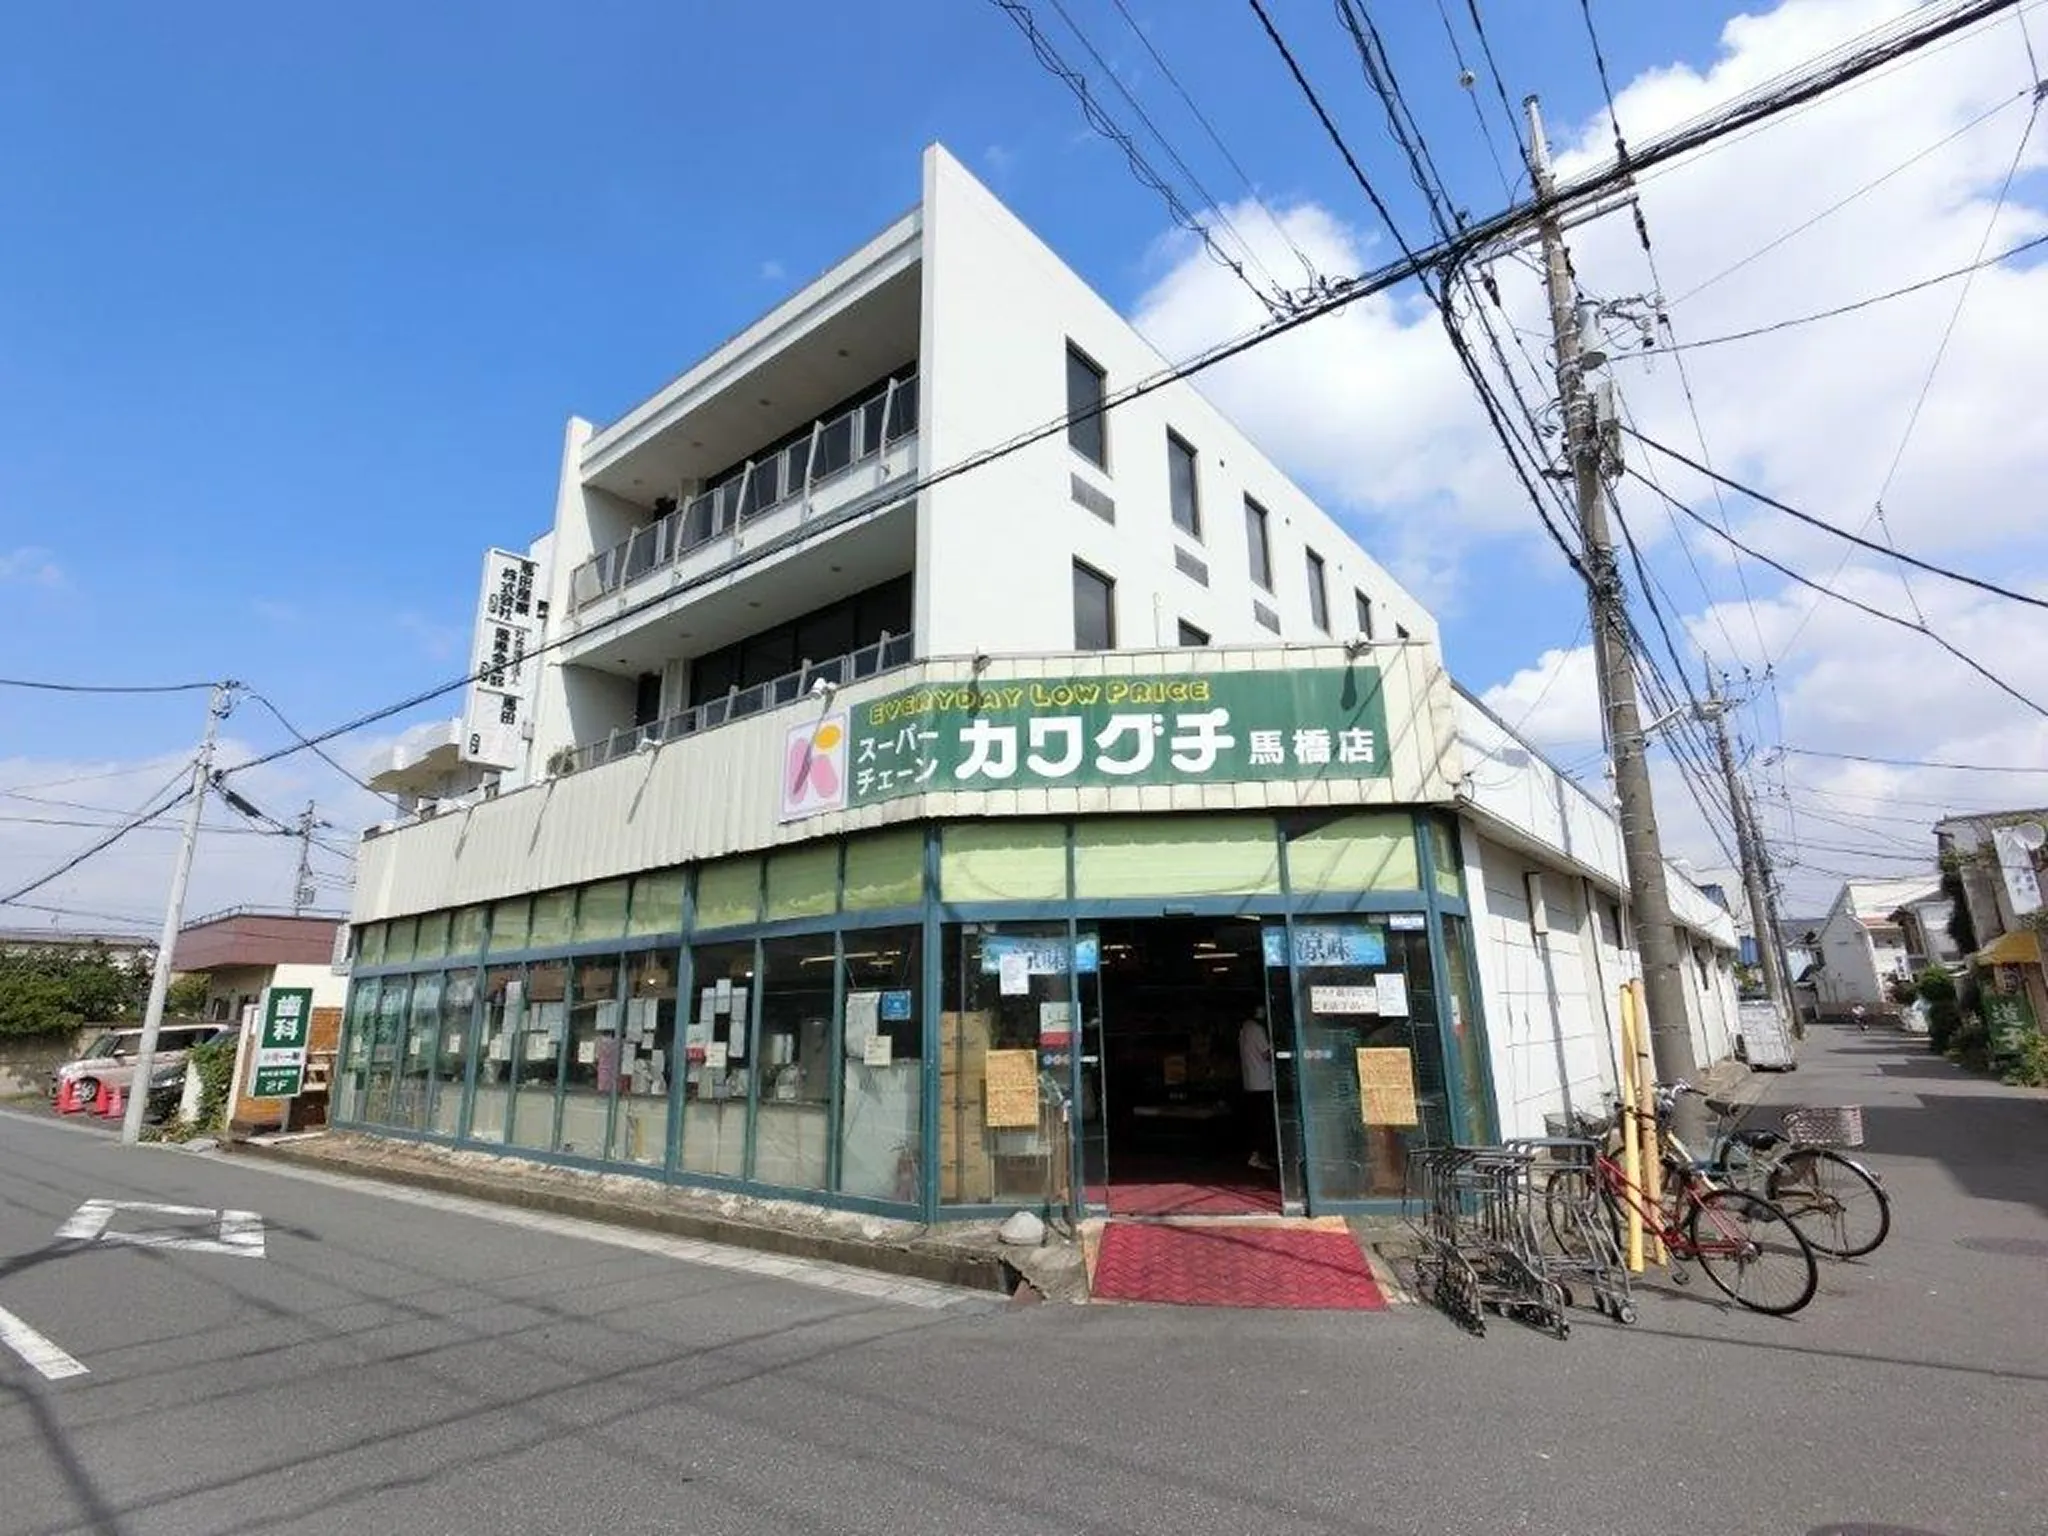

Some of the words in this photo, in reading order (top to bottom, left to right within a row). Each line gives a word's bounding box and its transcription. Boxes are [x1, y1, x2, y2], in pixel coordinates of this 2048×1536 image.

[499, 566, 517, 620] 株式会社
[869, 687, 1023, 725] EVERYDAY
[1029, 683, 1100, 707] LOW
[1105, 679, 1210, 704] PRICE
[857, 722, 939, 765] スーパー
[954, 707, 1236, 780] カワグチ
[1248, 726, 1375, 765] 馬橋店
[856, 758, 939, 797] チェーン
[273, 994, 303, 1041] 歯科
